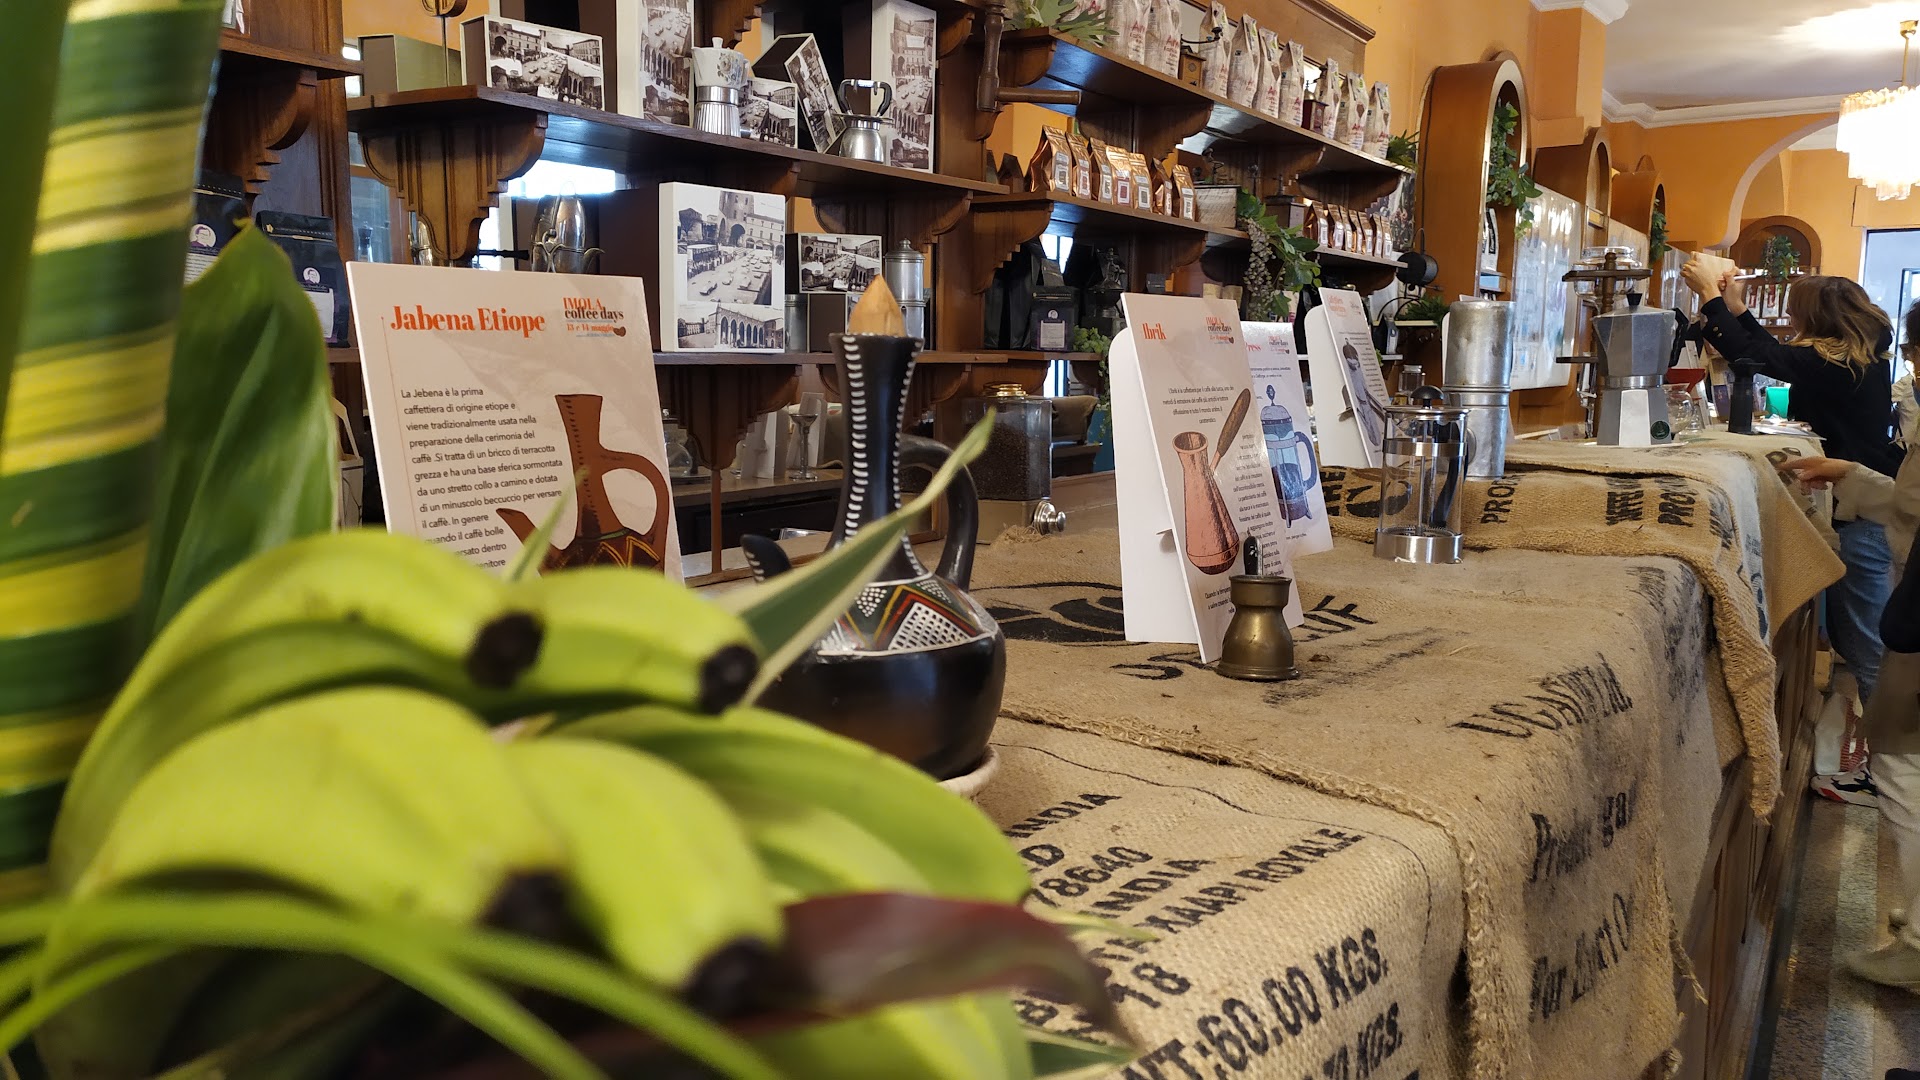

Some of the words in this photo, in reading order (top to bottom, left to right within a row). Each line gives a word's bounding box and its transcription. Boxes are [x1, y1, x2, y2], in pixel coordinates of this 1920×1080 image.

[563, 297, 603, 310] IMOLA
[390, 304, 476, 331] Jabena
[477, 307, 546, 339] Etiope
[564, 306, 599, 320] coffee
[600, 306, 624, 323] days
[400, 389, 411, 399] La
[413, 387, 444, 399] Jebena
[445, 387, 450, 397] è
[451, 387, 460, 397] la
[461, 388, 484, 398] prima
[404, 403, 445, 415] caffettiera
[446, 402, 454, 413] di
[455, 403, 484, 414] origine
[485, 402, 509, 413] etiope
[406, 420, 429, 431] viene
[430, 417, 497, 430] tradizionalmente
[498, 418, 518, 426] usata
[519, 415, 537, 425] nella
[409, 436, 463, 450] preparazione
[465, 433, 484, 444] della
[485, 430, 522, 442] cerimonia
[523, 430, 535, 440] del
[412, 452, 432, 464] caffè
[444, 451, 466, 461] tratta
[467, 449, 475, 460] di
[476, 450, 487, 459] un
[488, 446, 511, 458] bricco
[512, 445, 520, 455] di
[521, 444, 556, 455] terracotta
[414, 471, 442, 483] grezza
[450, 467, 460, 477] ha
[461, 467, 476, 477] una
[478, 465, 496, 475] base
[497, 463, 522, 474] sferica
[522, 460, 563, 471] sormontata
[417, 487, 428, 497] da
[430, 487, 446, 496] uno
[447, 483, 472, 494] stretto
[474, 480, 493, 491] collo
[500, 477, 528, 488] camino
[535, 474, 558, 485] dotata
[419, 502, 428, 513] di
[430, 503, 441, 512] un
[442, 497, 483, 510] minuscolo
[484, 494, 522, 506] beccuccio
[522, 492, 535, 503] per
[536, 489, 562, 499] versare
[421, 519, 428, 529] il
[451, 515, 460, 525] In
[461, 514, 489, 527] genere
[458, 530, 463, 540] il
[464, 527, 483, 540] caffè
[484, 526, 504, 536] bolle
[481, 543, 507, 553] dentro
[1002, 793, 1123, 838] INDIA
[1077, 859, 1217, 919] INDIA
